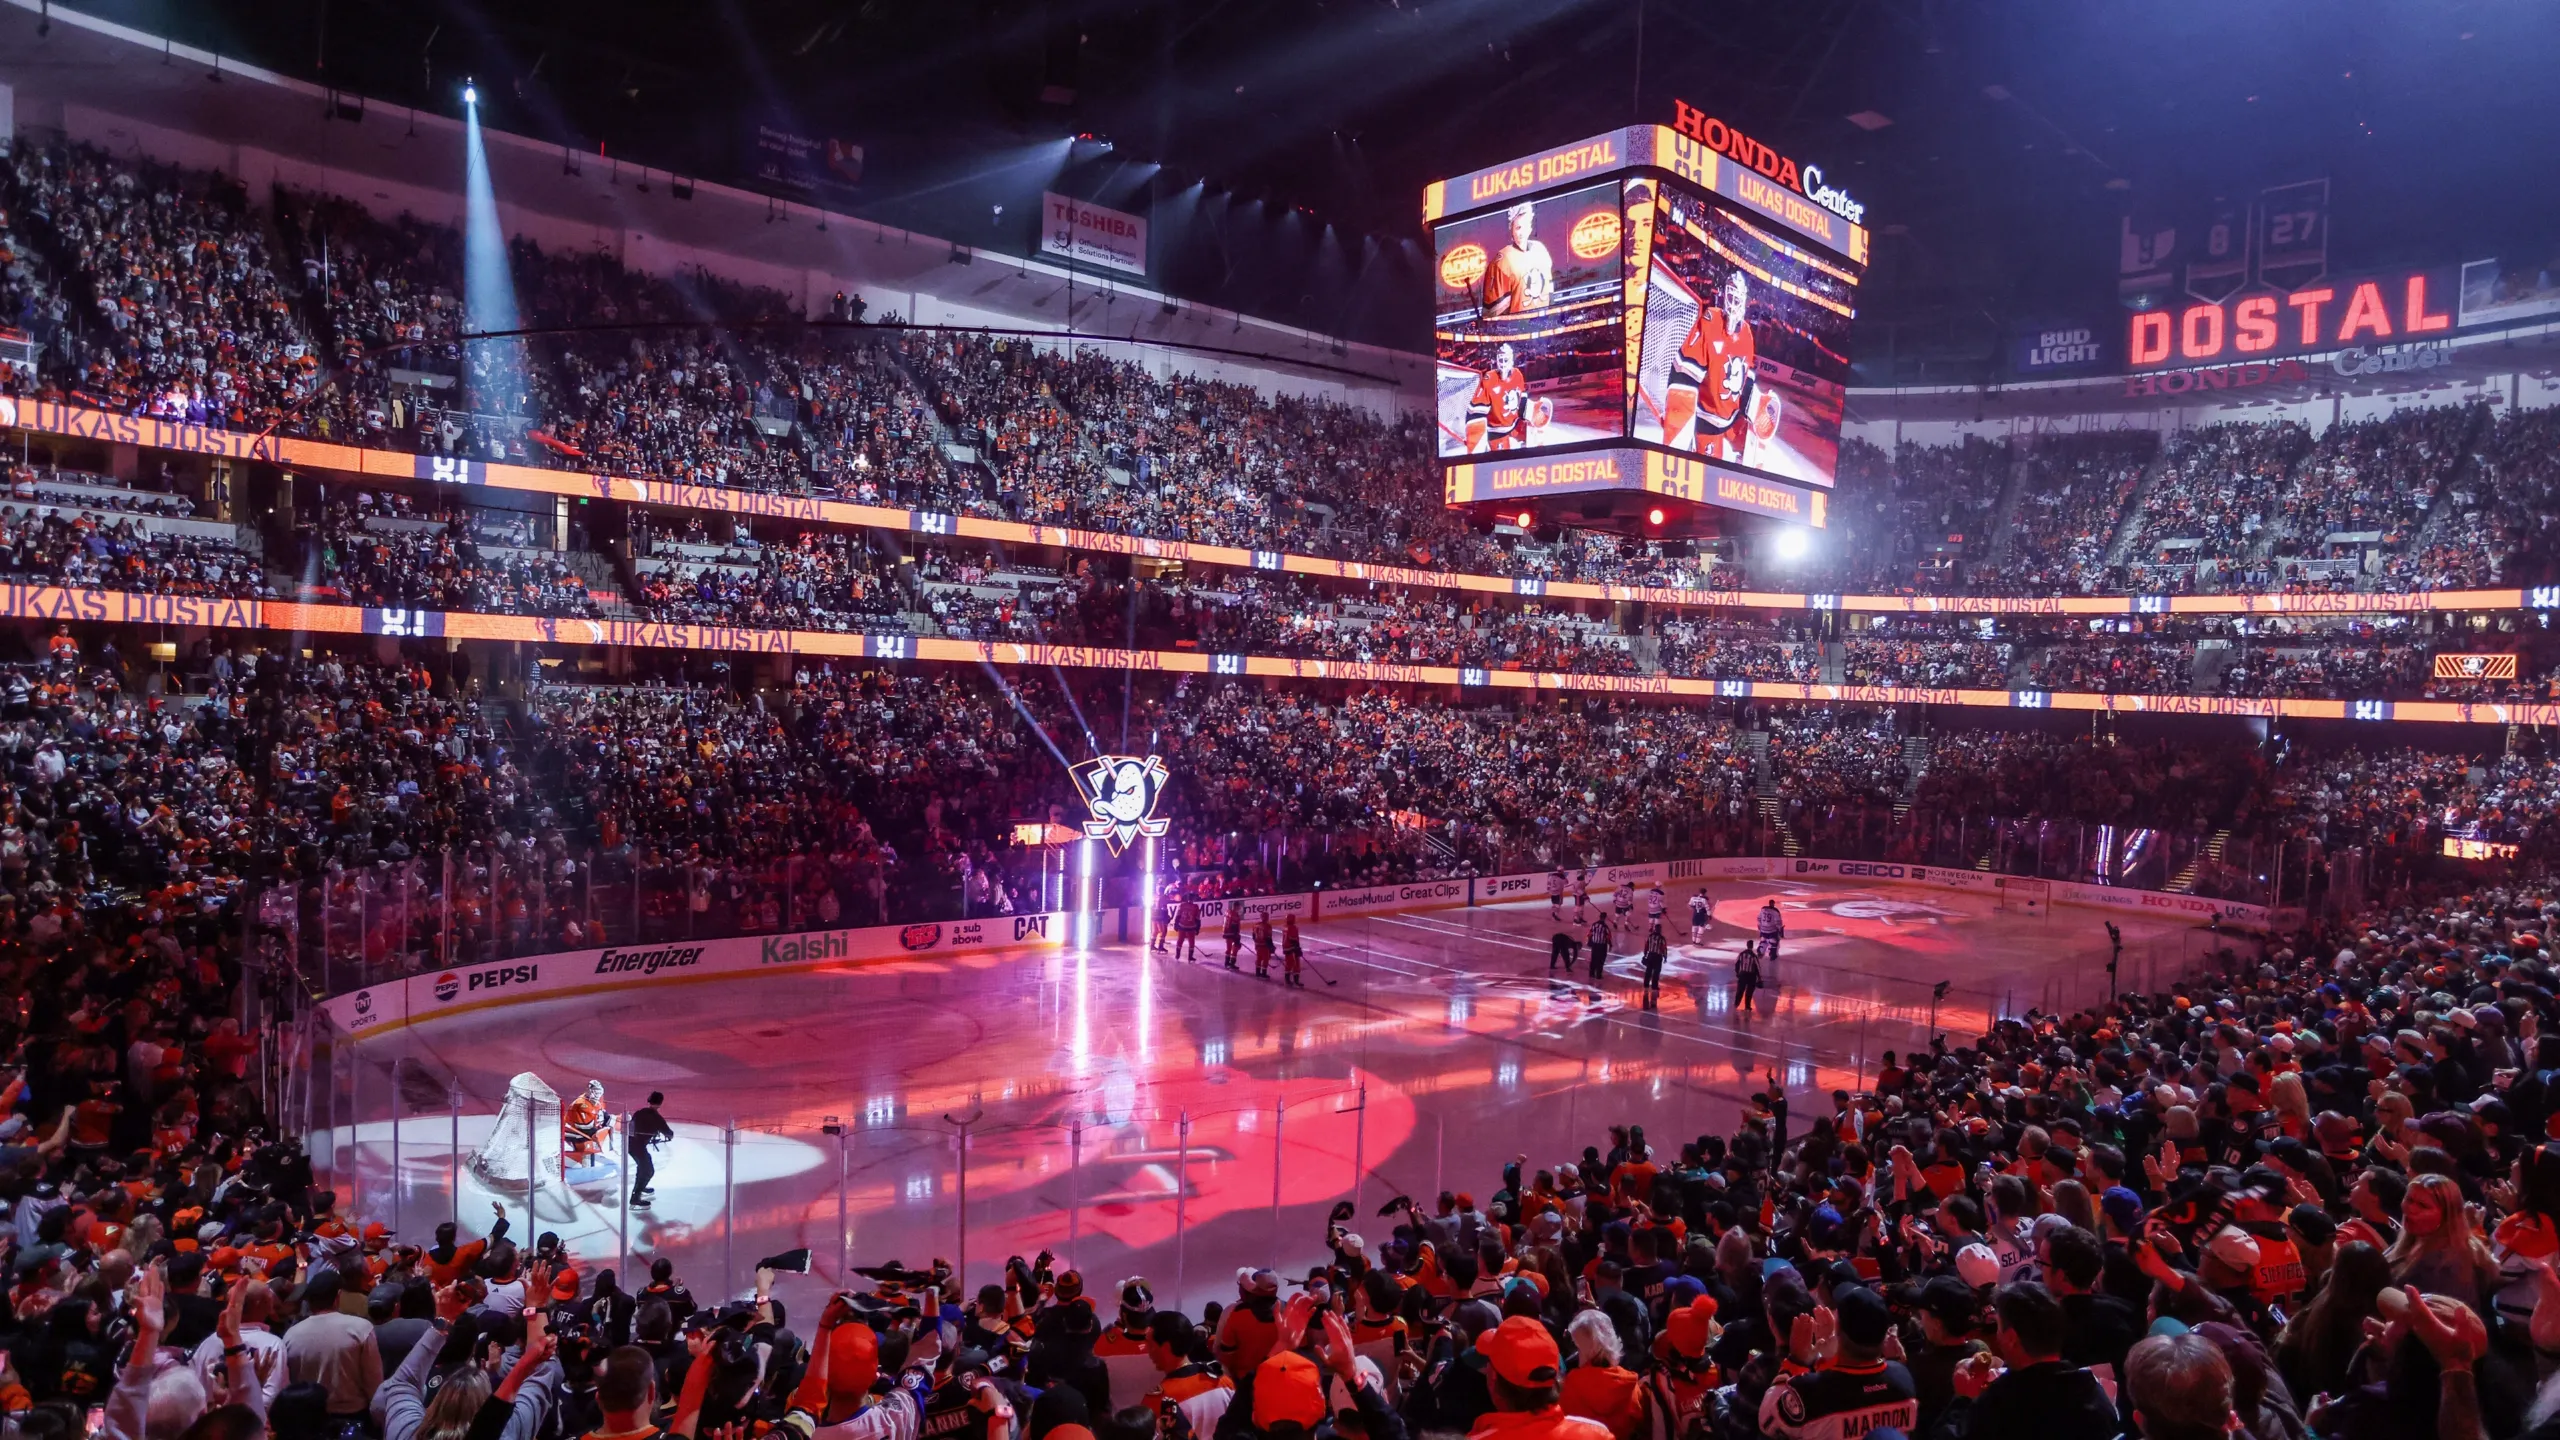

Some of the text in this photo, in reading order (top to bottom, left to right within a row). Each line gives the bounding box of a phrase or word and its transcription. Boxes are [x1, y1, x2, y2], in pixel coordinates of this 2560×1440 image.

[1473, 140, 1616, 200] LUKAS DOSTAL
[1673, 99, 1864, 224] HONDA Center
[1738, 174, 1832, 240] LUKAS DOSTAL
[1053, 203, 1138, 240] TOSHIBA
[2270, 211, 2317, 245] 27
[1079, 238, 1137, 259] Official Document
[1079, 247, 1135, 266] Solutions Partner
[2130, 275, 2451, 365] DOSTAL
[2041, 328, 2090, 347] BUD
[2030, 344, 2100, 365] LIGHT
[2124, 345, 2452, 398] HONDA Center
[15, 400, 293, 464] LUKAS DOSTAL
[1493, 459, 1618, 490] LUKAS DOSTAL
[646, 481, 828, 521] LUKAS DOSTAL
[1718, 477, 1799, 514] LUKAS DOSTAL
[1066, 527, 1193, 560] LUKAS DOSTAL
[1362, 563, 1462, 589] LUKAS DOSTAL
[1631, 586, 1746, 606] LUKAS DOSTAL
[1936, 596, 2065, 613] LUKAS DOSTAL
[2280, 592, 2437, 612] LUKAS DOSTAL
[123, 591, 269, 628] DOSTAL
[601, 620, 800, 653] LUKAS DOSTAL
[1024, 643, 1163, 670] LUKAS DOSTAL
[1322, 661, 1425, 683] LUKAS DOSTAL
[1563, 673, 1673, 694] LUKAS DOSTAL
[1835, 685, 1963, 705] LUKAS DOSTAL
[2140, 696, 2288, 717] LUKAS DOSTAL
[1618, 868, 1655, 880] Polymarket
[1669, 860, 1704, 878] NOBULL
[1838, 862, 1905, 878] GEICO
[1927, 869, 1983, 881] NORWEGIAN
[1400, 884, 1460, 900] Great Clips
[1501, 878, 1531, 891] PEPSI
[1243, 901, 1302, 914] nterprise
[1338, 891, 1395, 908] MassMutual
[953, 923, 981, 934] a sub
[1014, 915, 1050, 942] CAT
[761, 931, 848, 964] Kalshi
[952, 935, 983, 945] above
[595, 945, 705, 975] Energizer
[435, 982, 459, 993] PEPSI
[468, 964, 538, 991] PEPSI
[351, 1014, 377, 1029] SPORTS
[924, 1410, 971, 1436] ANNE
